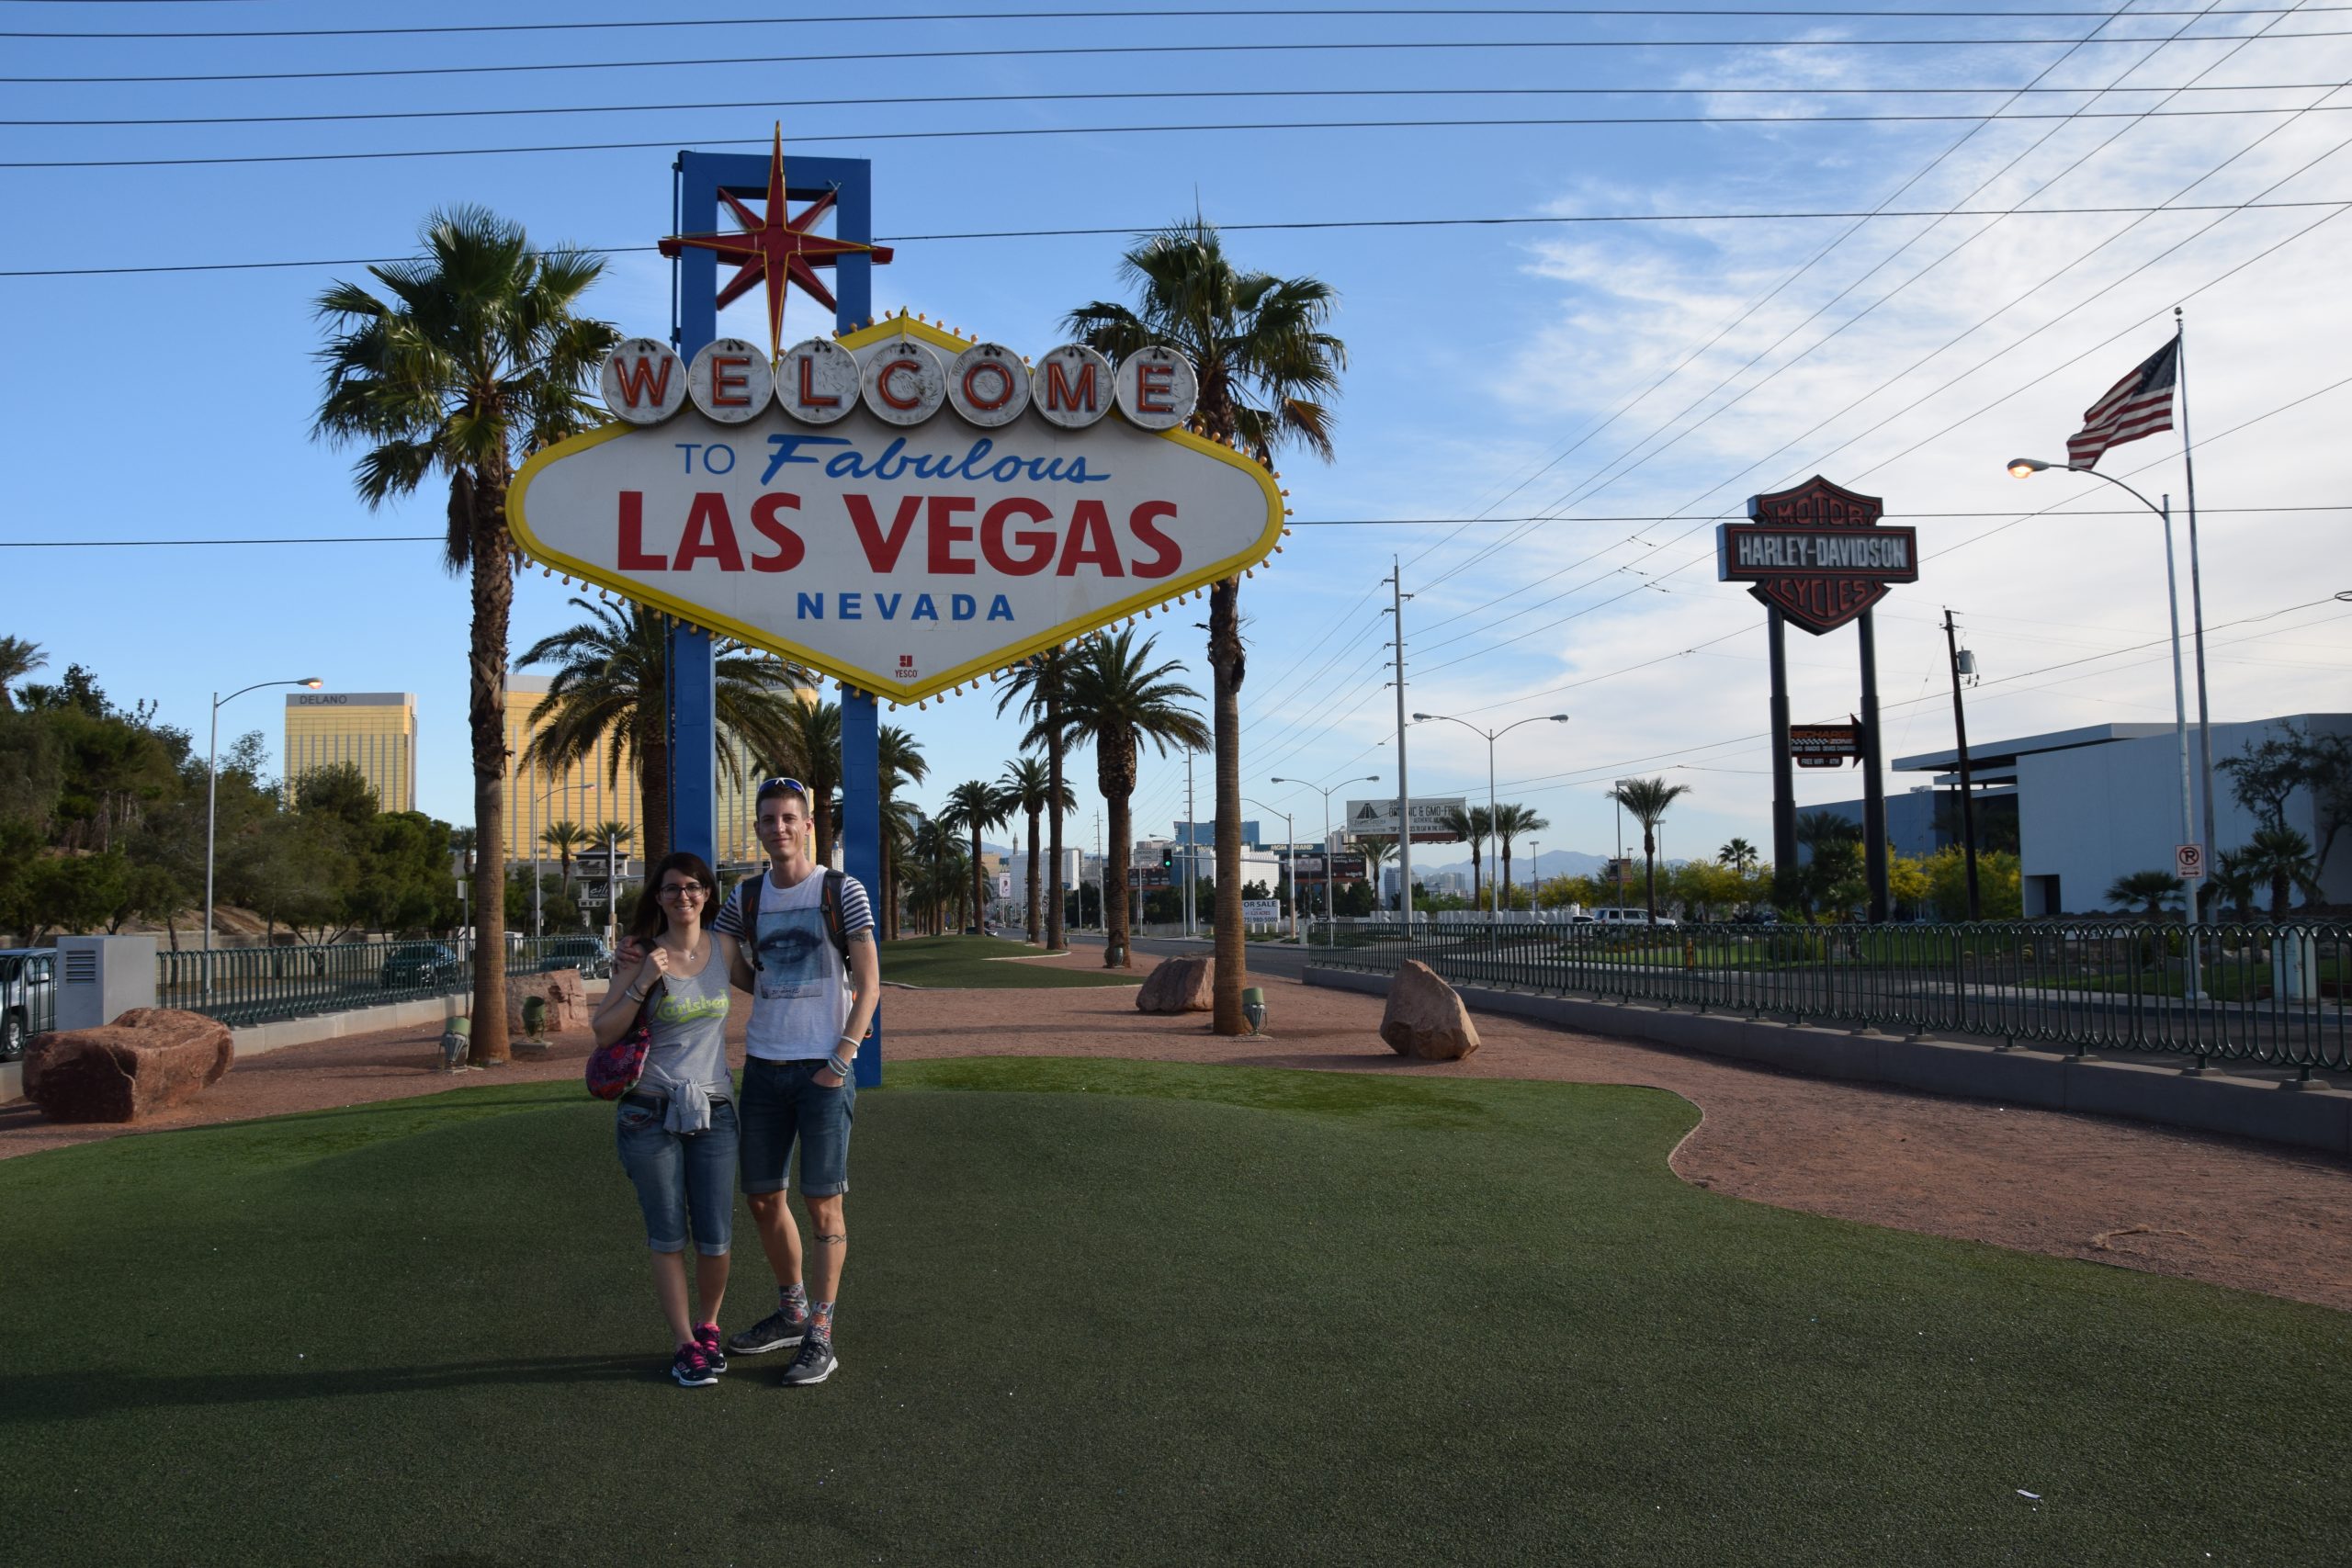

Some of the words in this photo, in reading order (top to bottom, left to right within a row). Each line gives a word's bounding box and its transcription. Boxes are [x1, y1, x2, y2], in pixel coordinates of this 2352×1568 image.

[613, 355, 1178, 413] WELCOME
[675, 444, 735, 475] TO
[760, 434, 1112, 486] Fabulous
[1777, 491, 1867, 525] MOTOR
[617, 491, 806, 573] LAS
[842, 495, 1183, 579] VEGAS
[1738, 535, 1907, 568] HARLEY-DAVIDSON
[797, 592, 1015, 622] NEVADA
[1781, 579, 1867, 618] CYCLES
[895, 669, 918, 678] YESCO
[300, 695, 347, 705] DELANO
